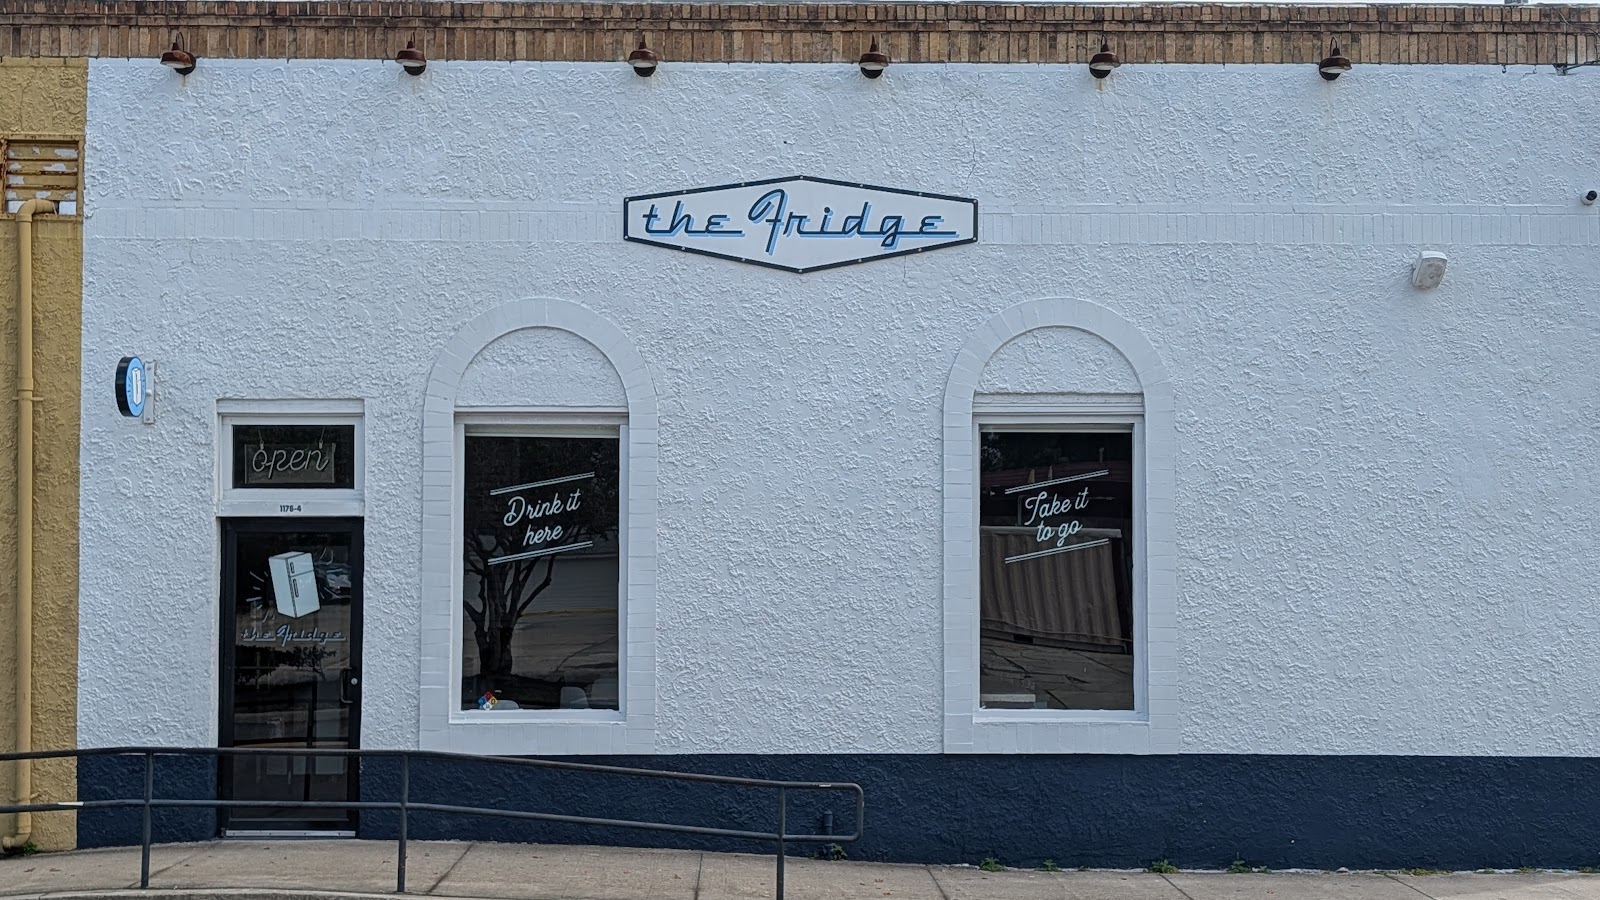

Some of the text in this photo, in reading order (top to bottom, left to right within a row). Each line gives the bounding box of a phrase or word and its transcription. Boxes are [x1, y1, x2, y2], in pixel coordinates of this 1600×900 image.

[642, 188, 960, 256] the Fridge
[252, 449, 329, 479] open
[503, 488, 582, 527] Drink it
[1024, 486, 1090, 526] Take it
[522, 524, 564, 547] here
[1036, 520, 1084, 548] to go
[240, 624, 347, 648] the Fridge
